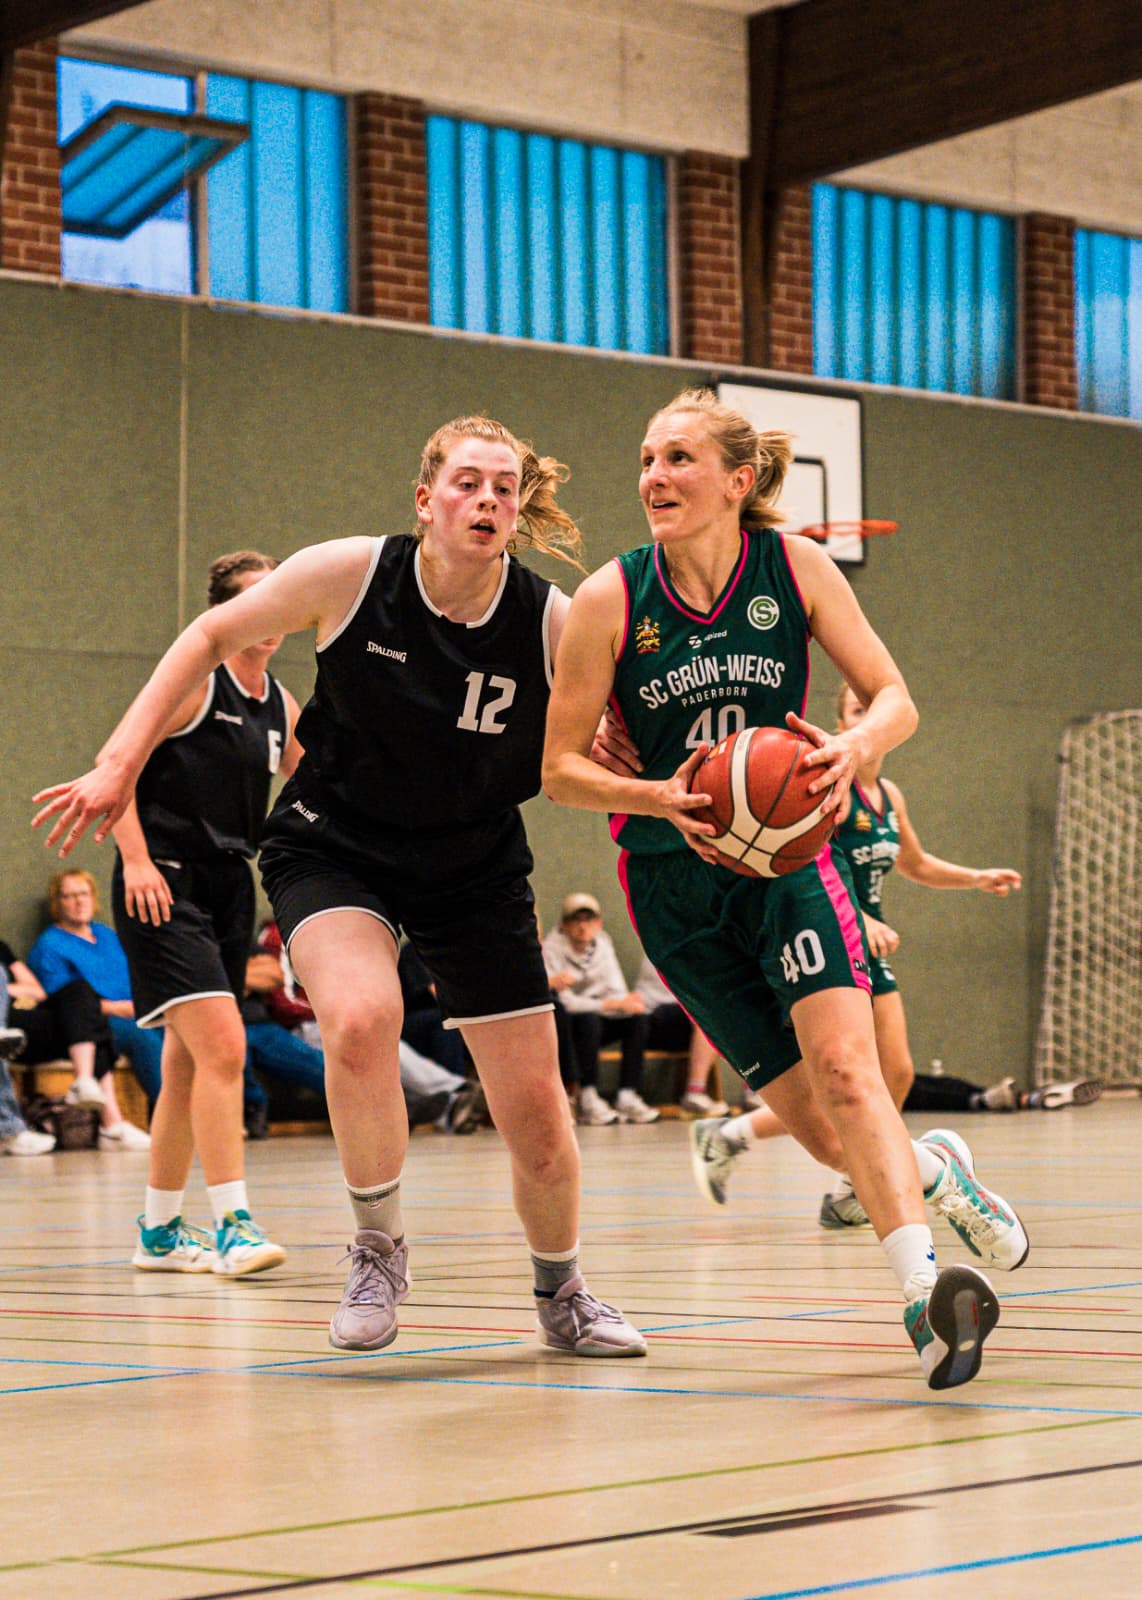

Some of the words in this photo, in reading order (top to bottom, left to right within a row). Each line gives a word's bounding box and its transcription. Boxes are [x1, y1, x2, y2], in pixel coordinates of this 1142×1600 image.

[366, 641, 408, 663] SPALDING
[456, 671, 517, 734] 12
[639, 679, 668, 710] SC
[666, 654, 785, 697] GRÜN-WEISS
[682, 686, 748, 707] PADERBORN
[685, 704, 746, 751] 40
[780, 929, 826, 984] 40
